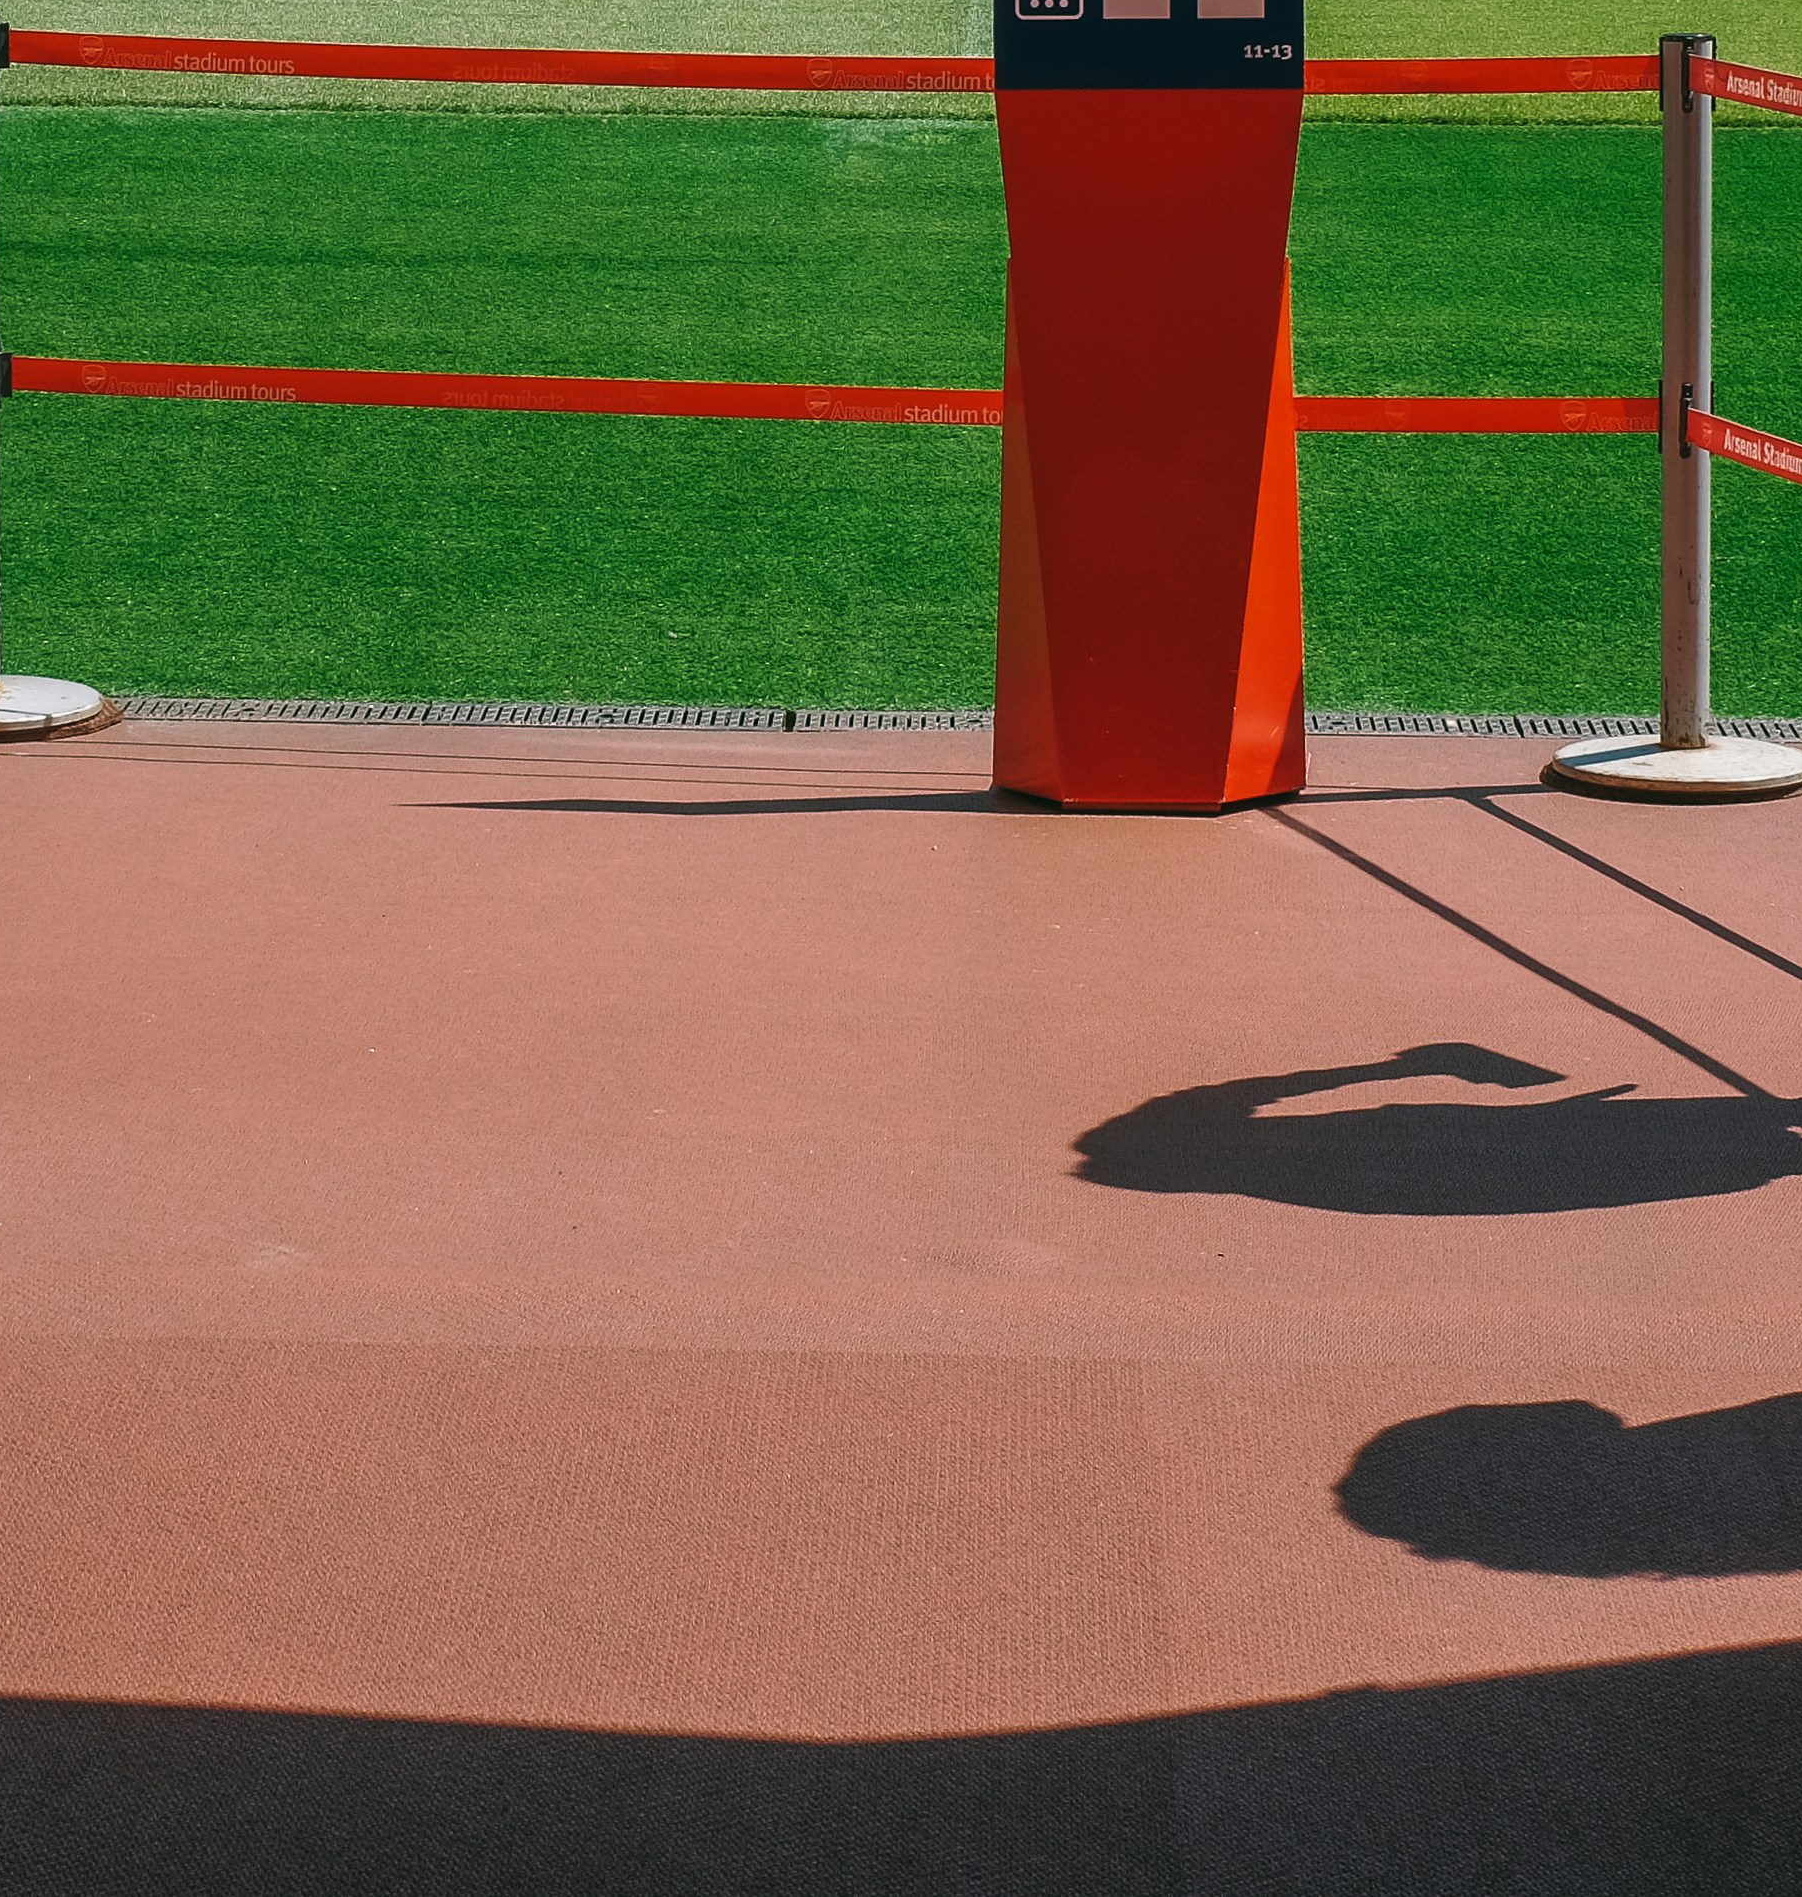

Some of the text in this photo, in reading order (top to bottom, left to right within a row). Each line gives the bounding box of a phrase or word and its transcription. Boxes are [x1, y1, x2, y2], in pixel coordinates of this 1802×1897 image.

[173, 52, 247, 72] stadium
[249, 53, 296, 74] tours
[1243, 44, 1294, 61] 11-13
[905, 71, 981, 90] stadium
[1726, 69, 1765, 100] Arsenal
[176, 380, 247, 401] stadium
[251, 383, 297, 402] tours
[903, 403, 979, 424] stadium
[1723, 428, 1762, 460] Arsenal
